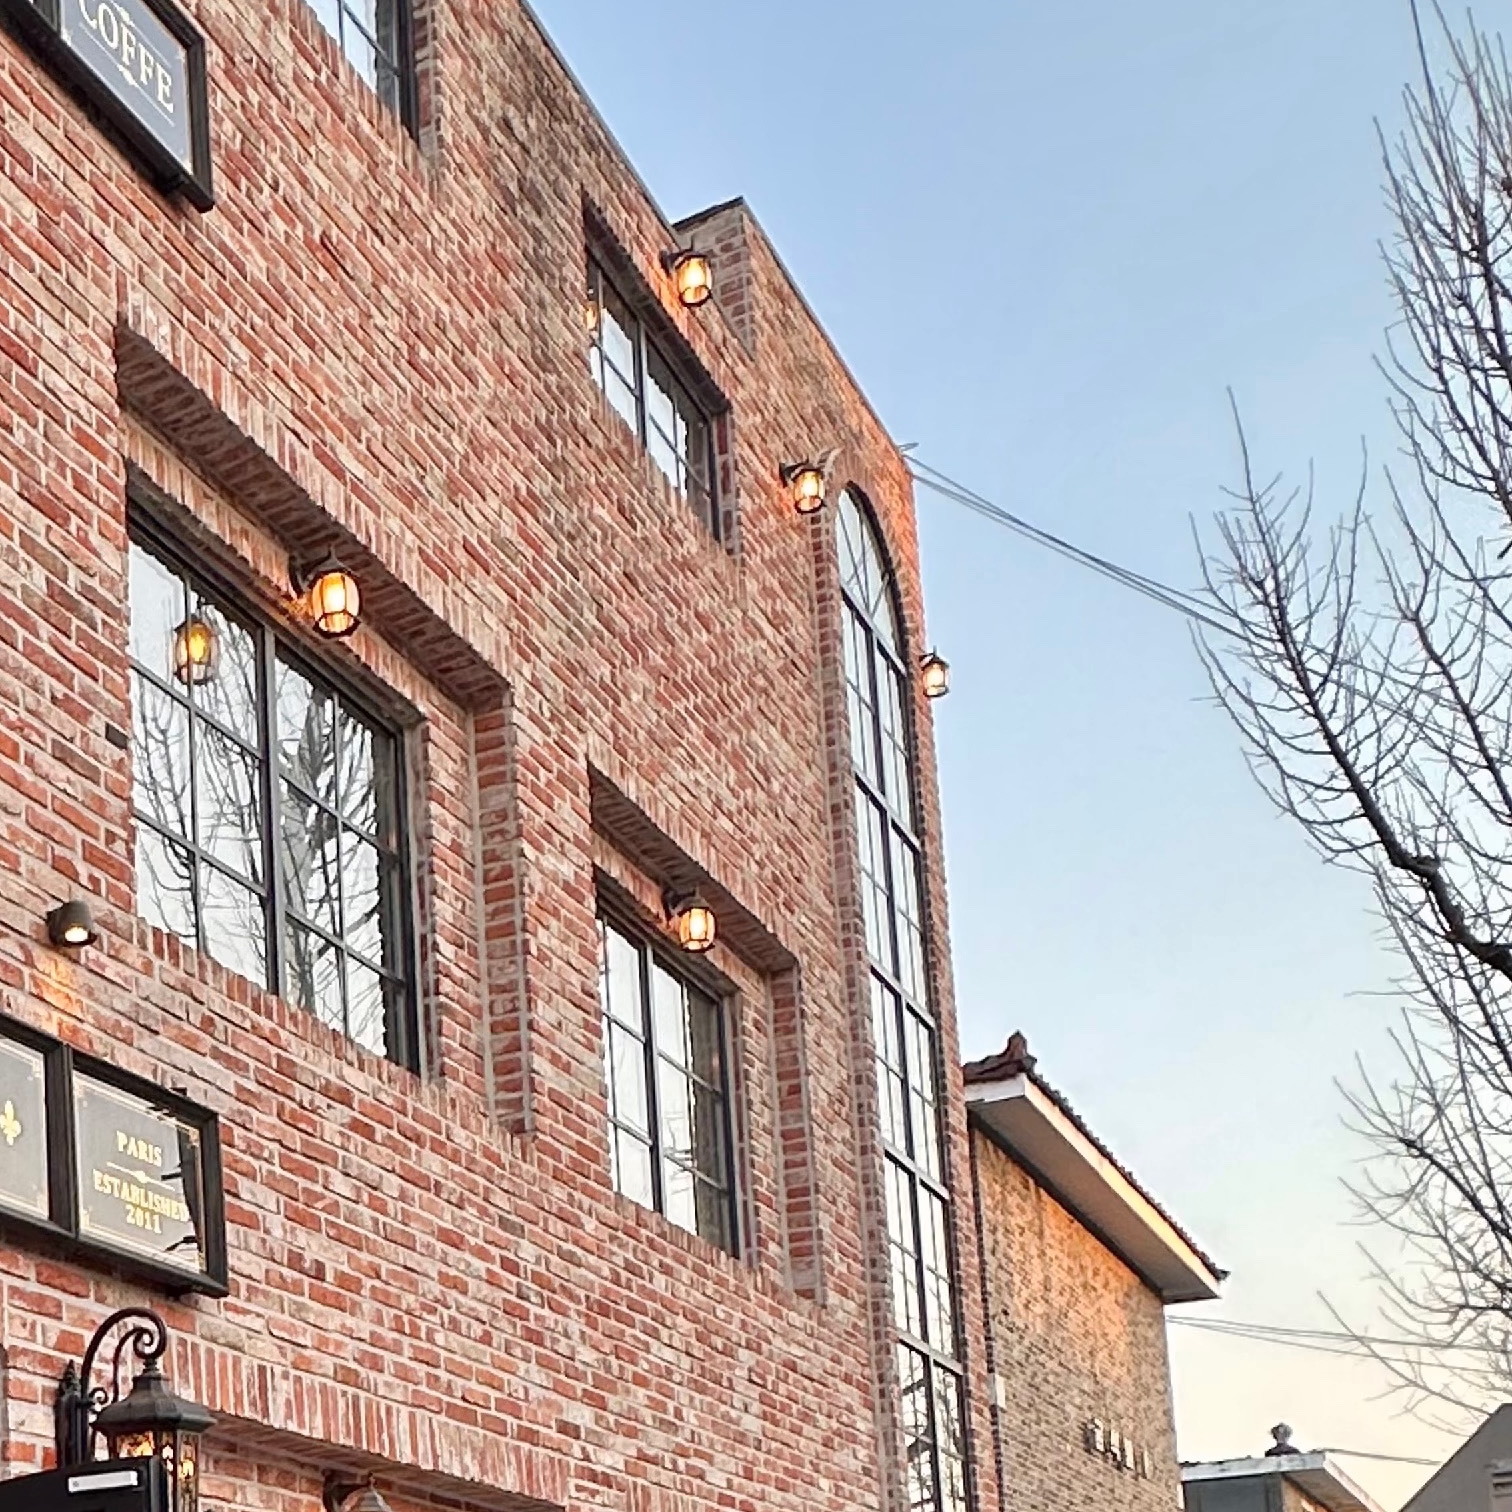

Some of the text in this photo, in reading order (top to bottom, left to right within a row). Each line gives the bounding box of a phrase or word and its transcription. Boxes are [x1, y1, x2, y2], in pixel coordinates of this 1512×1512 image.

[117, 1130, 162, 1167] PARIS
[93, 1168, 190, 1222] ESTABLISHED
[126, 1204, 162, 1234] 2011
